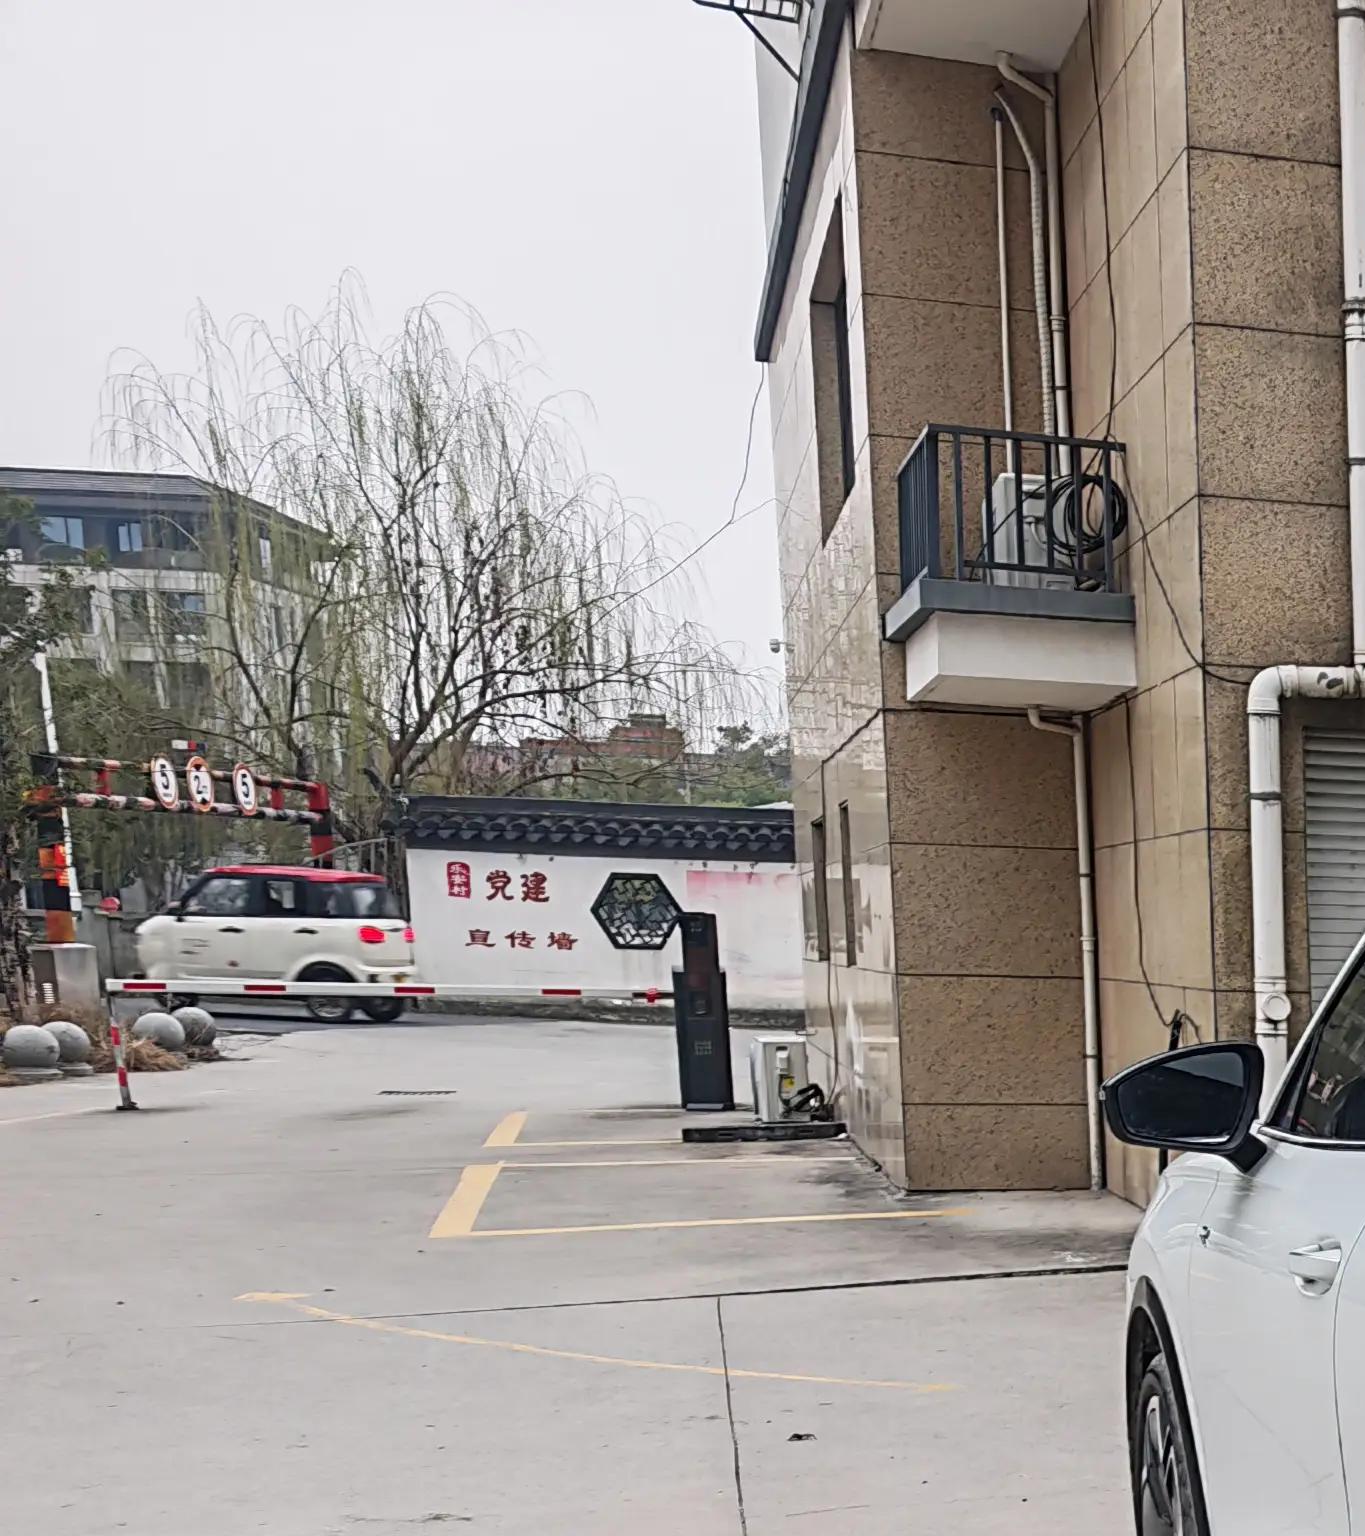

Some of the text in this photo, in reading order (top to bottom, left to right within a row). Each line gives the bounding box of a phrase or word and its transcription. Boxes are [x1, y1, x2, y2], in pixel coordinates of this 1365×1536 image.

[159, 763, 170, 790] 5
[241, 773, 250, 799] 5
[449, 863, 470, 897] 乐安村
[485, 869, 550, 903] 党建
[464, 928, 579, 951] 宣传墙
